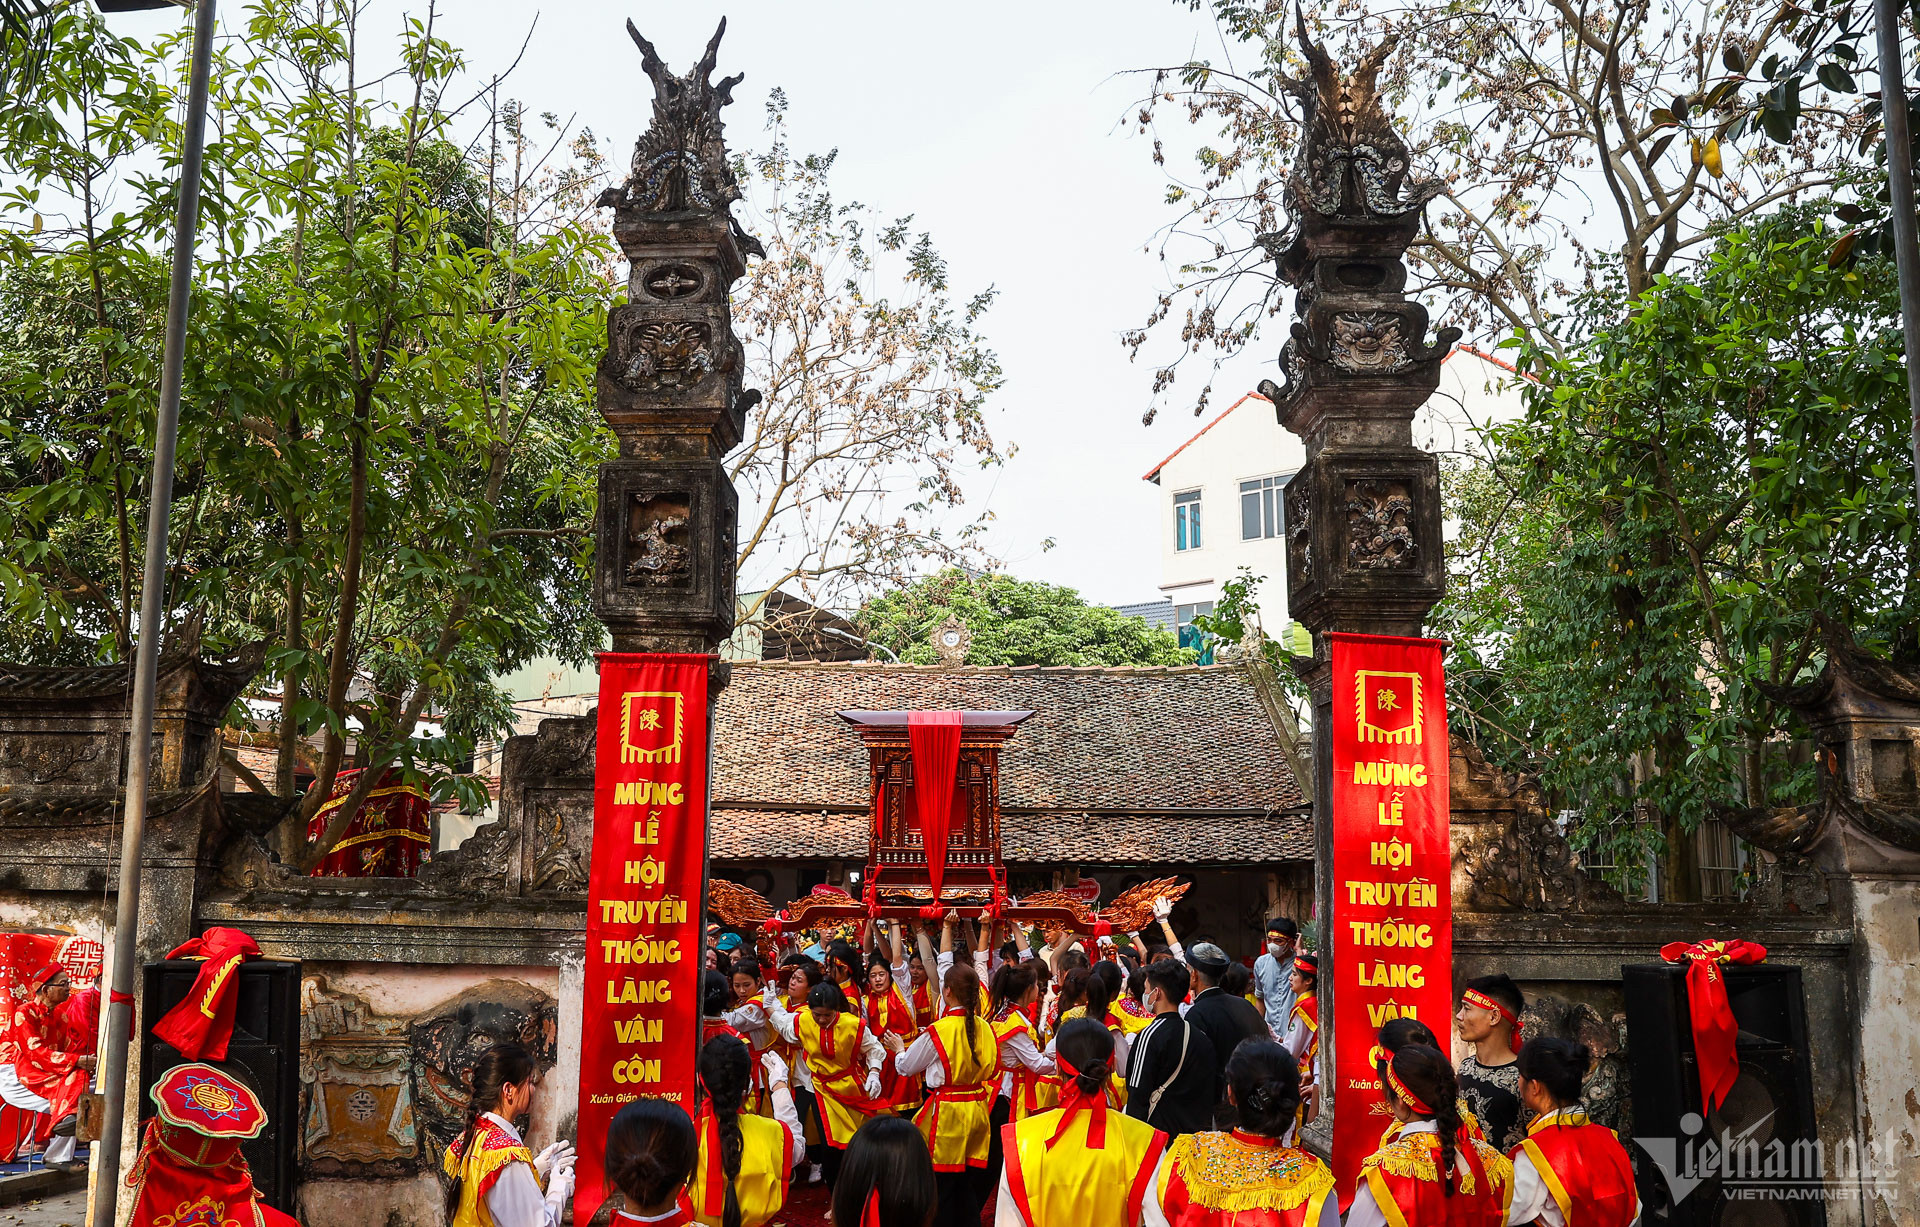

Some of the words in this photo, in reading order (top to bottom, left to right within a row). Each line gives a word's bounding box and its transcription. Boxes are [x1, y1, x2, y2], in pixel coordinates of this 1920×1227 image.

[1353, 758, 1428, 787] MỪNG
[613, 778, 684, 806] MỪNG
[1378, 791, 1405, 826] LỄ
[633, 810, 662, 845] LỄ
[1370, 836, 1412, 871] HỘI
[624, 854, 665, 889] HỘI
[1345, 876, 1437, 908] TRUYỀN
[599, 894, 688, 924] TRUYỀN
[1349, 916, 1433, 949] THỐNG
[601, 934, 682, 964] THỐNG
[1358, 959, 1425, 988] LÀNG
[606, 976, 672, 1004] LÀNG
[613, 1013, 663, 1044] VÂN
[612, 1053, 661, 1084] CÔN
[589, 1093, 614, 1104] Xuân
[1348, 1078, 1372, 1090] Xuân
